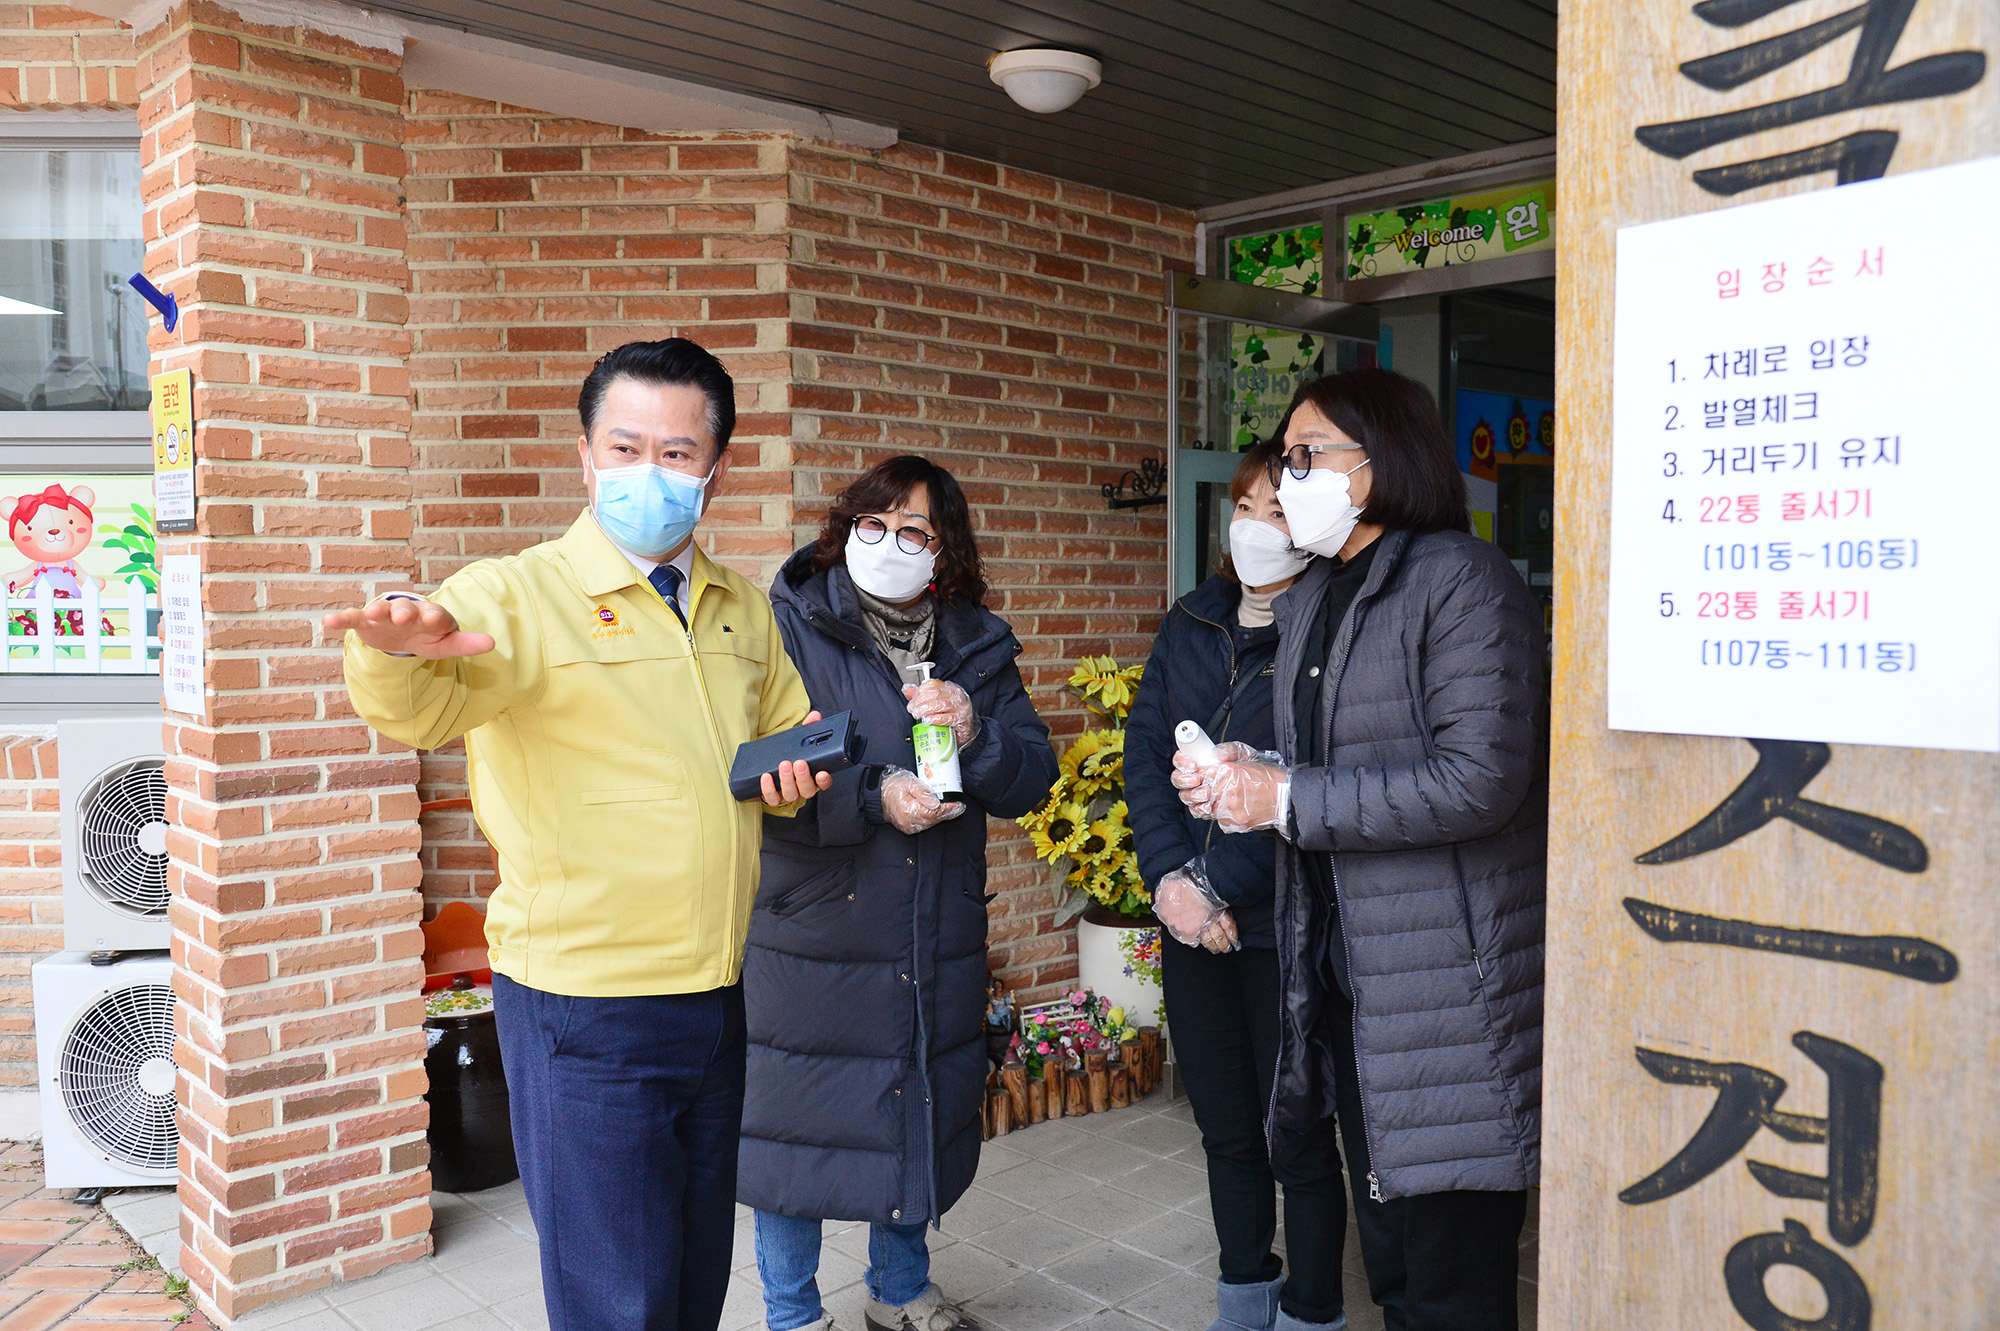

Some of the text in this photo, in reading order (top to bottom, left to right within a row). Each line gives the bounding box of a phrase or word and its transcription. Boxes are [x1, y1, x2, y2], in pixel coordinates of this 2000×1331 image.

[1394, 223, 1484, 252] Welcome
[1667, 334, 1871, 383] 1. 차례로 입장
[163, 381, 179, 409] 금연
[1663, 392, 1819, 431] 2. 발열체크
[1663, 435, 1900, 478] 3. 거리두기 유지
[1662, 488, 1872, 524] 4. 22통 줄서기
[1703, 538, 1919, 572] (101동~106동)
[1660, 590, 1870, 620] 5. 23통 줄서기
[1702, 639, 1917, 673] (107동~111동)
